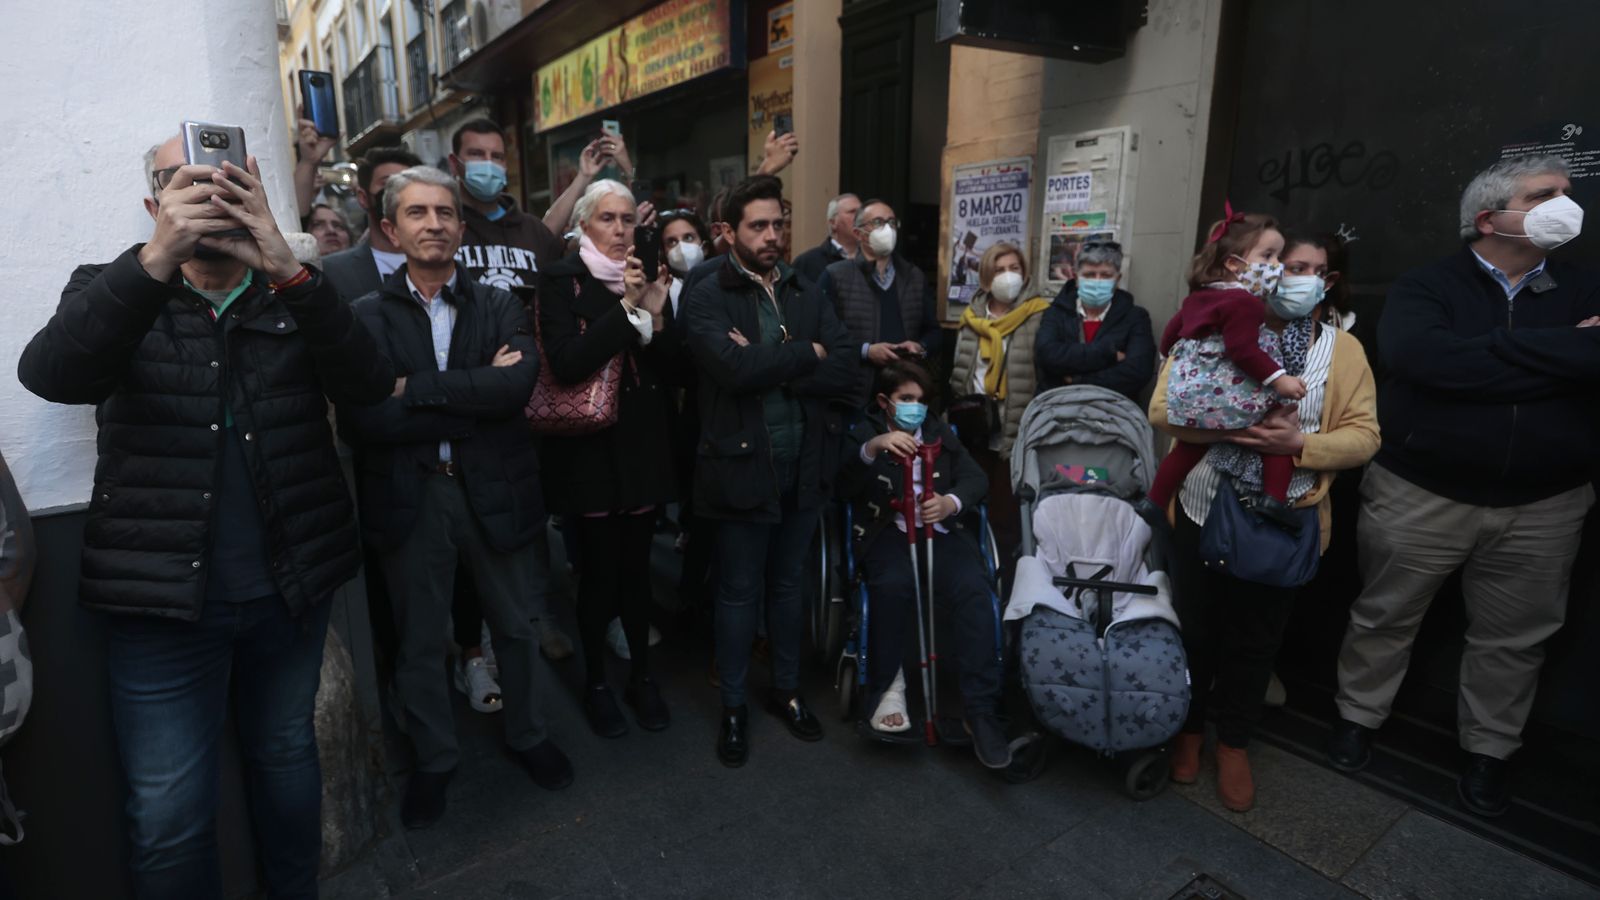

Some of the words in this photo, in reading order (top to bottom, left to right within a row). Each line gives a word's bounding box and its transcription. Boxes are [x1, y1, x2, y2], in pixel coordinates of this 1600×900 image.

[635, 19, 675, 46] FRUTOS
[678, 2, 717, 27] SECOS
[672, 68, 685, 81] DE
[690, 53, 726, 76] HELIO
[1048, 175, 1090, 192] PORTES
[958, 199, 968, 217] 8
[970, 192, 1023, 216] MARZO
[966, 216, 989, 227] HUELGA
[991, 214, 1021, 225] GENERAL
[980, 224, 1021, 236] ESTUDIANTIL
